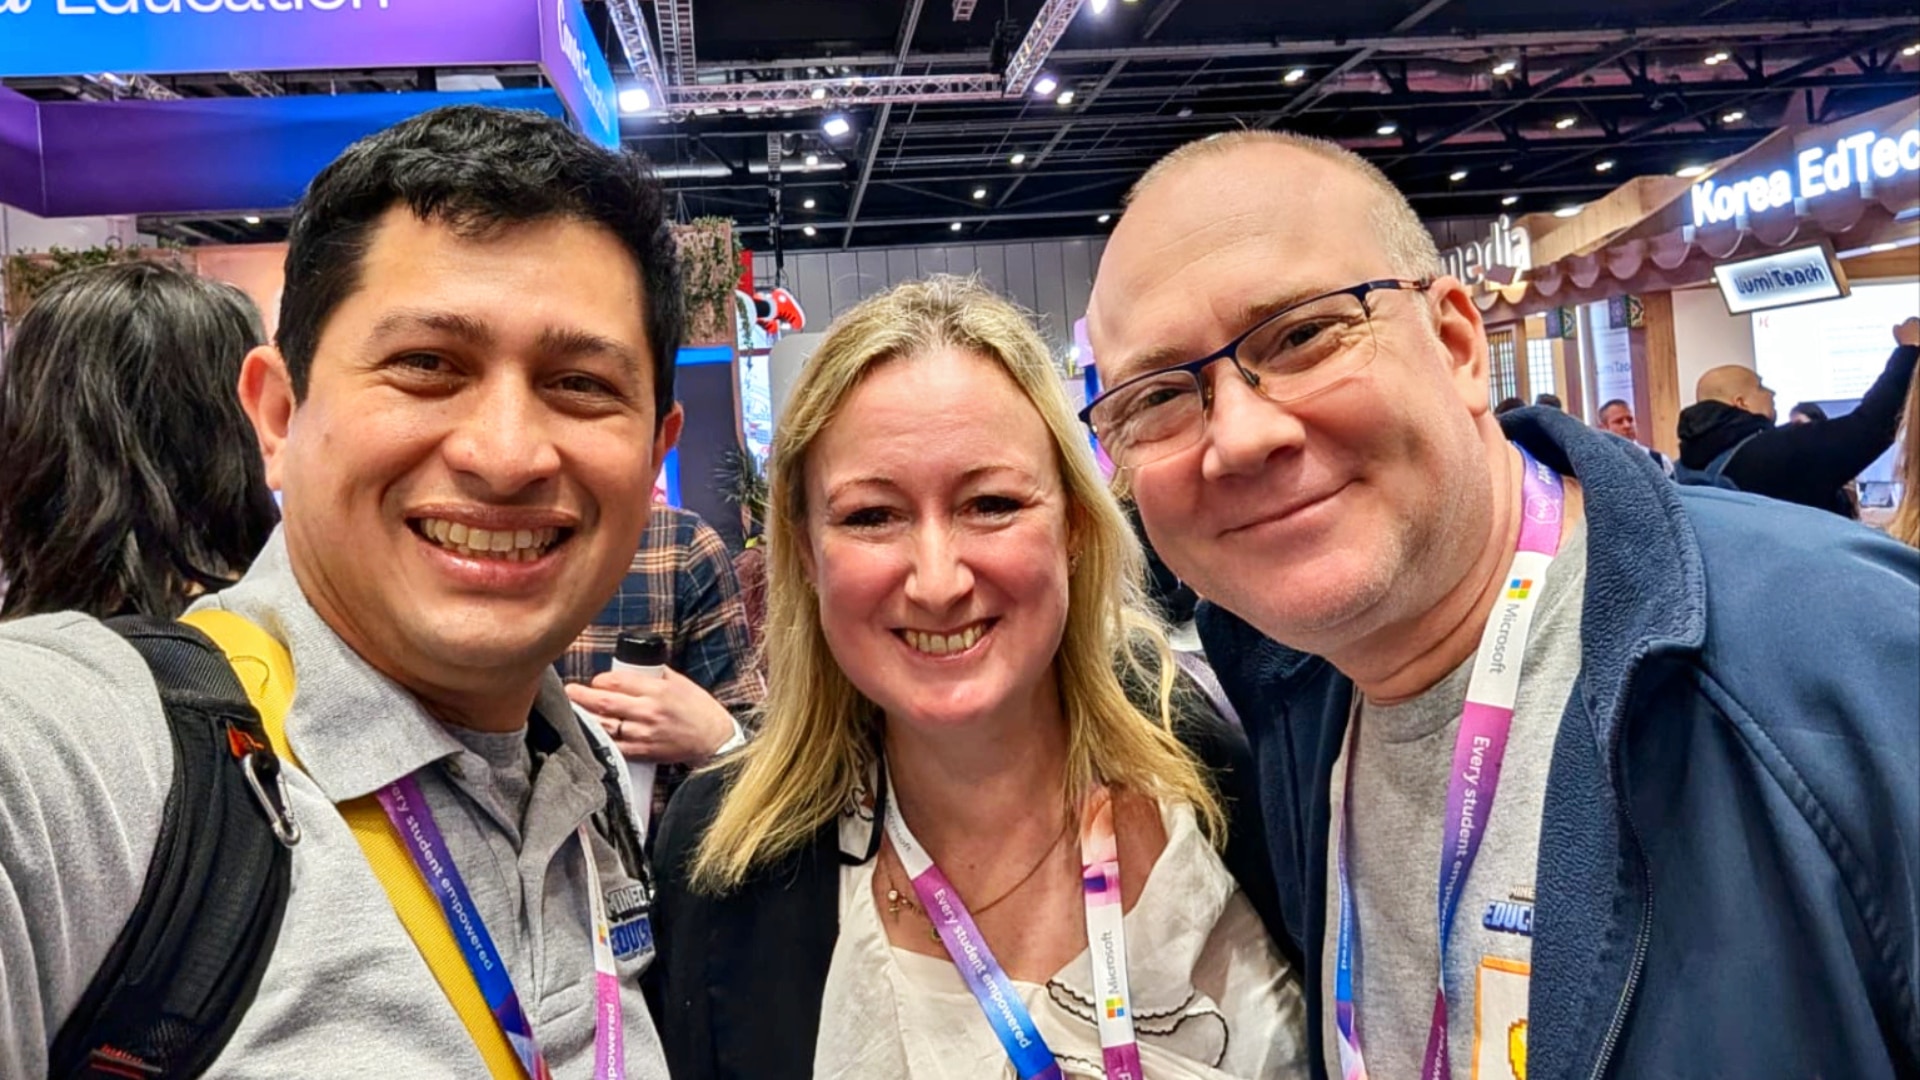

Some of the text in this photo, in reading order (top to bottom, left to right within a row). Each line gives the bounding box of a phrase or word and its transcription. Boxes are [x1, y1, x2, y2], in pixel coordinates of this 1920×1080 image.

[1691, 129, 1919, 227] Korea EdTec
[1489, 602, 1521, 674] Microsoft
[1463, 736, 1491, 785] Every
[1457, 788, 1478, 857] student
[406, 815, 444, 878] student
[440, 877, 493, 971] empowered
[1484, 900, 1534, 933] EDUC
[934, 888, 1032, 1049] Every student empowered
[1101, 929, 1119, 995] Microsoft
[606, 1003, 618, 1080] powered
